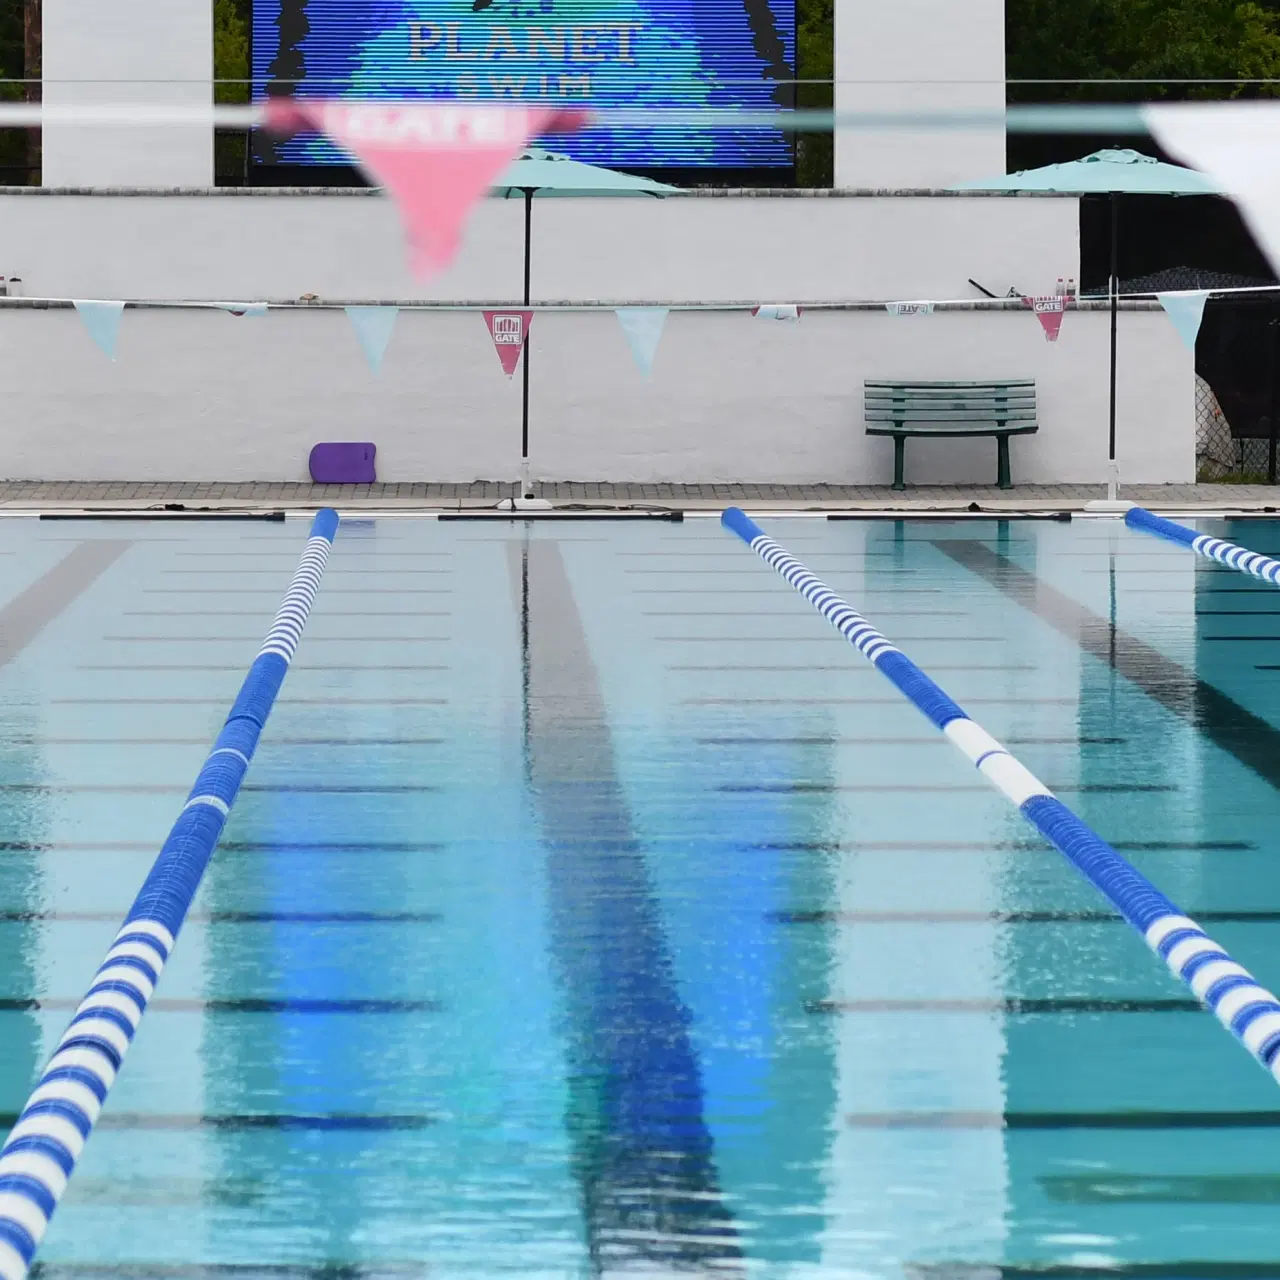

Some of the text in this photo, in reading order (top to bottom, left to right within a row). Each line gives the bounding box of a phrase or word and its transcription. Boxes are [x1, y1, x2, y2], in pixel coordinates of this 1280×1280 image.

[407, 21, 643, 64] PLANET
[456, 71, 593, 97] SWIM
[1035, 302, 1061, 311] GATE
[495, 334, 520, 343] GATE
